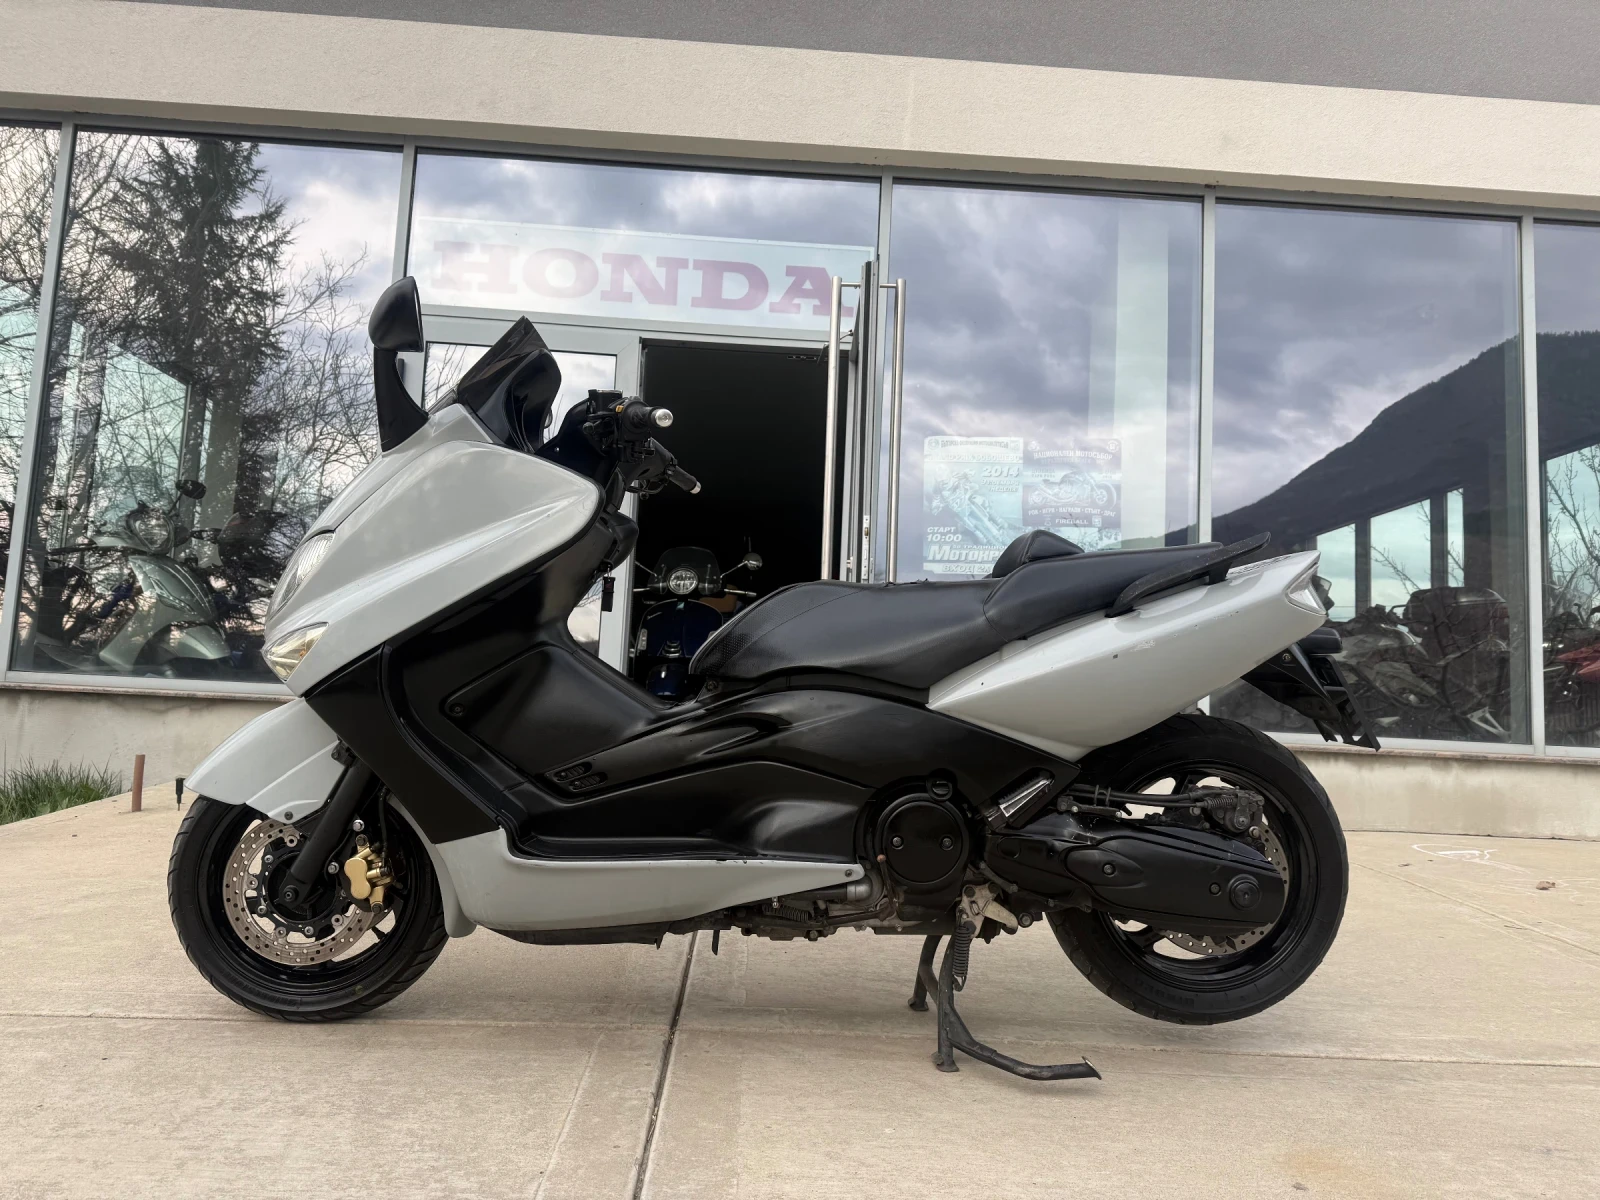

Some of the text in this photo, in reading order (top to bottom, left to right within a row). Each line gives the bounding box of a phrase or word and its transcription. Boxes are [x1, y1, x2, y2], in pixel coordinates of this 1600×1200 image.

[430, 240, 854, 317] HONDA
[1075, 450, 1113, 460] МОТОСЪБОР
[981, 465, 1020, 478] 2014
[926, 533, 962, 542] 10:00
